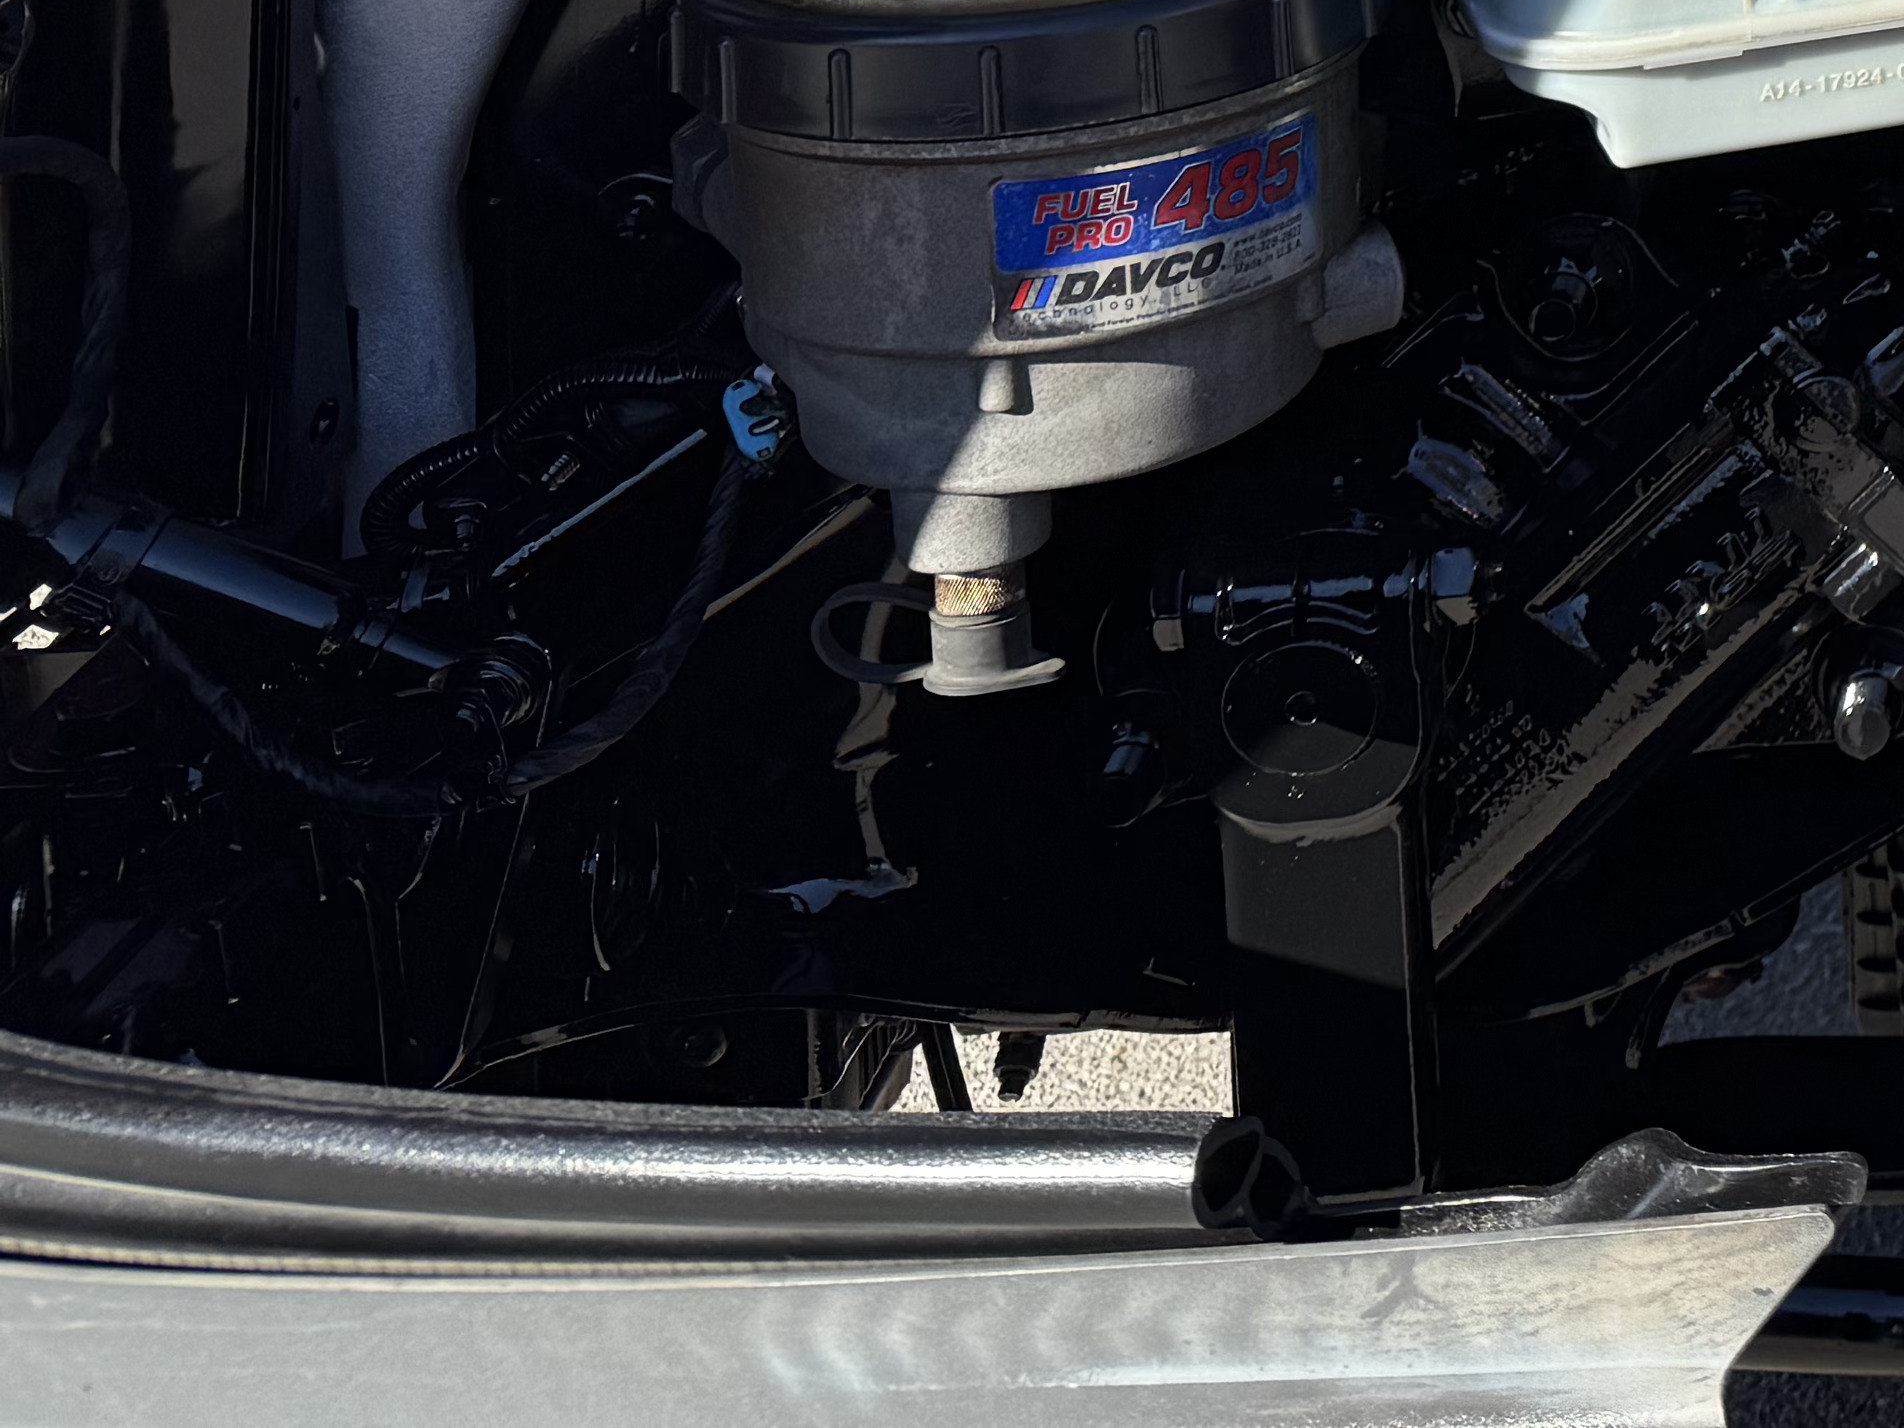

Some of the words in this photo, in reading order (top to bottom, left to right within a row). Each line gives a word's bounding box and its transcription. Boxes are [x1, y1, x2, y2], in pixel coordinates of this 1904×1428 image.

[1033, 182, 1138, 225] FUEL
[1151, 125, 1303, 235] 485
[1044, 215, 1134, 256] PRO
[1054, 240, 1225, 307] DAVCO
